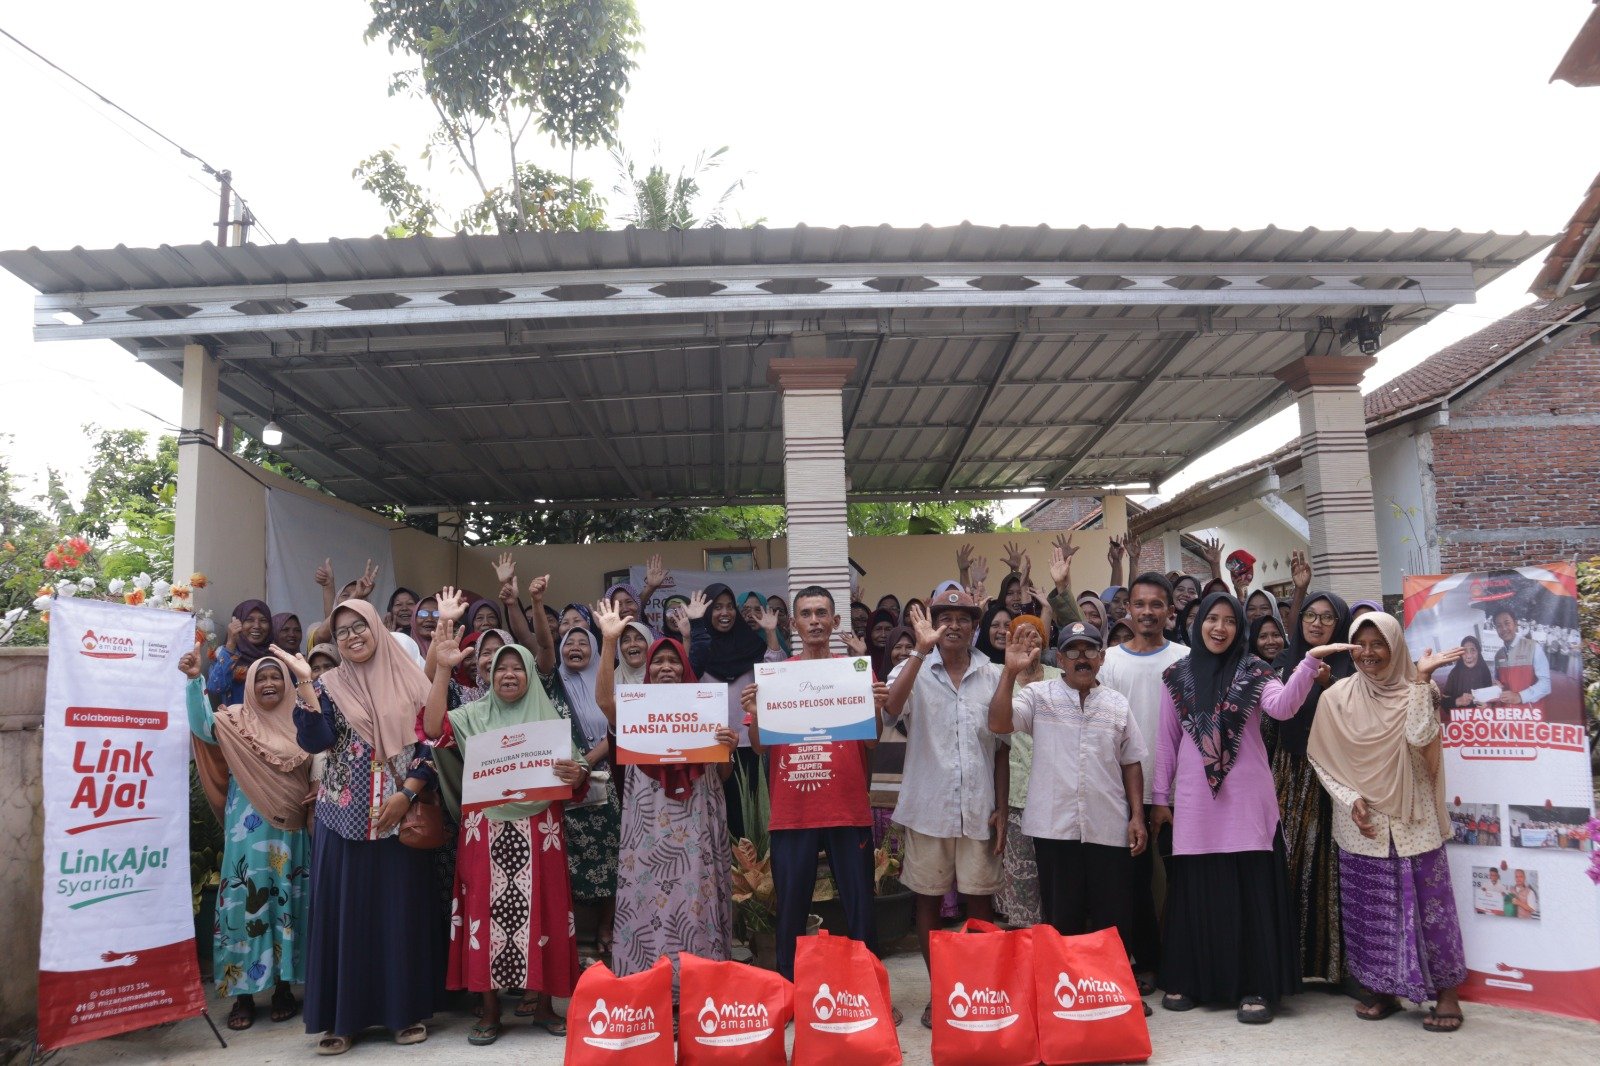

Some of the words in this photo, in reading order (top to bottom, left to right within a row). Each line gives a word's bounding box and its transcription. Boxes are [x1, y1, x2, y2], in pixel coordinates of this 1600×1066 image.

[98, 643, 134, 652] amanah
[99, 635, 134, 646] mizan
[799, 681, 835, 694] Program
[766, 700, 798, 710] BAKSOS
[799, 698, 835, 708] PELOSOK
[836, 696, 866, 705] NEGERI
[73, 713, 124, 723] Kolaborasi
[125, 715, 161, 726] Program
[648, 713, 699, 723] BAKSOS
[1450, 708, 1494, 721] INFAQ
[1495, 707, 1542, 721] BERAS
[622, 724, 668, 734] LANSIA
[1507, 722, 1584, 746] NEGERI
[797, 745, 824, 753] SUPER
[1472, 748, 1525, 756] INDONESIA
[73, 739, 154, 777] Link
[481, 754, 520, 767] PENYALURAN
[520, 749, 553, 759] PROGRAM
[797, 753, 822, 761] AWET
[472, 762, 517, 780] BAKSOS
[520, 758, 559, 770] LANSI
[796, 762, 823, 770] SUPER
[794, 771, 827, 779] UNTUNG
[70, 774, 148, 818] Aja!
[60, 845, 169, 875] LinkAja!
[57, 874, 134, 897] Syariah
[1077, 977, 1123, 995] mizan
[836, 990, 870, 1008] mizan
[971, 987, 1010, 1004] mizan
[1078, 992, 1126, 1004] amanah
[80, 997, 173, 1021] www.mizanamanah.org
[611, 1004, 655, 1022] mizan
[721, 1001, 768, 1018] mizan
[836, 1006, 872, 1018] amanah
[971, 1002, 1012, 1015] amanah
[609, 1019, 655, 1033] amanah
[720, 1016, 769, 1030] amanah
